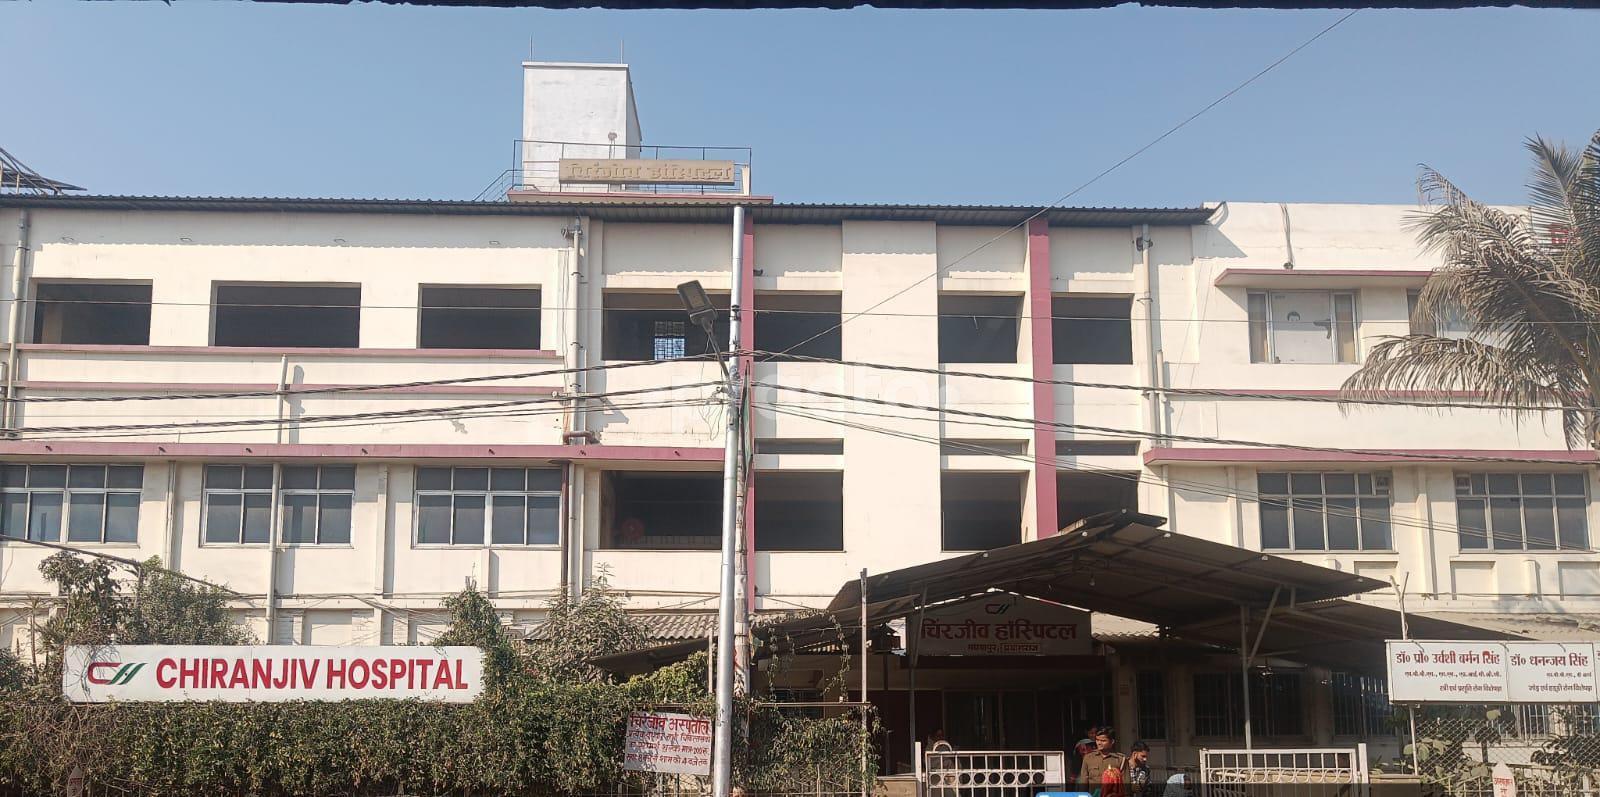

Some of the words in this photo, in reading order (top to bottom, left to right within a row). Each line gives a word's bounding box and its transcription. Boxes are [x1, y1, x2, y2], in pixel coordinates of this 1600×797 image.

[1432, 650, 1456, 664] उर्वशी
[1459, 650, 1480, 664] वर्मन
[1482, 650, 1500, 664] सिंह
[1529, 655, 1566, 666] धनन्जय
[1569, 652, 1588, 666] सिंह
[156, 657, 321, 690] CHIRANJIV
[327, 658, 468, 691] HOSPITAL
